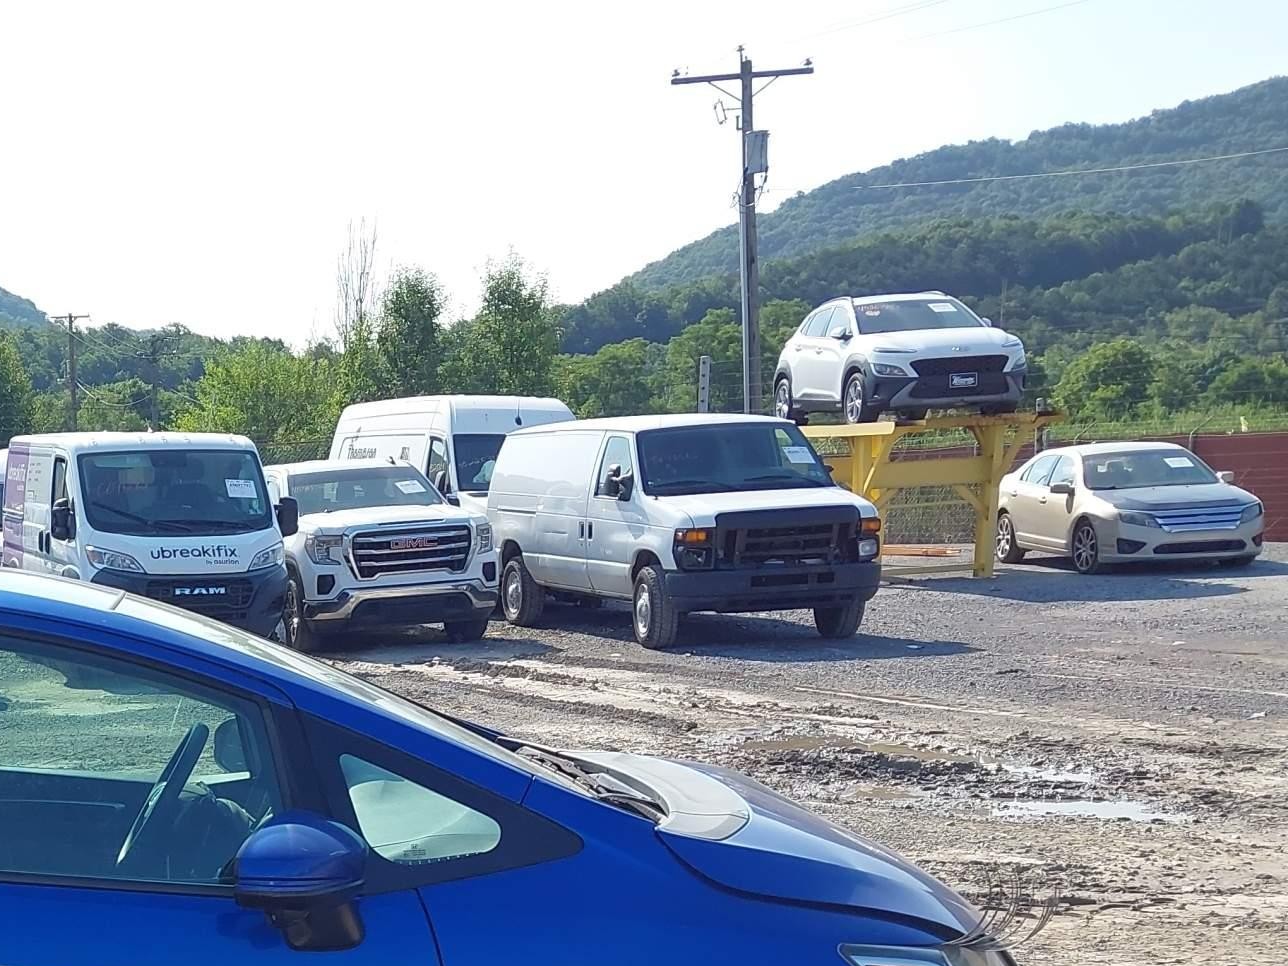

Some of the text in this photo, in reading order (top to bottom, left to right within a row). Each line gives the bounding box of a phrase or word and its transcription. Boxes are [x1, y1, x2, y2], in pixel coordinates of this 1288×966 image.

[390, 536, 439, 550] GMC
[150, 545, 238, 560] ubreakifix
[213, 558, 240, 566] asurion
[174, 586, 226, 596] RAM
